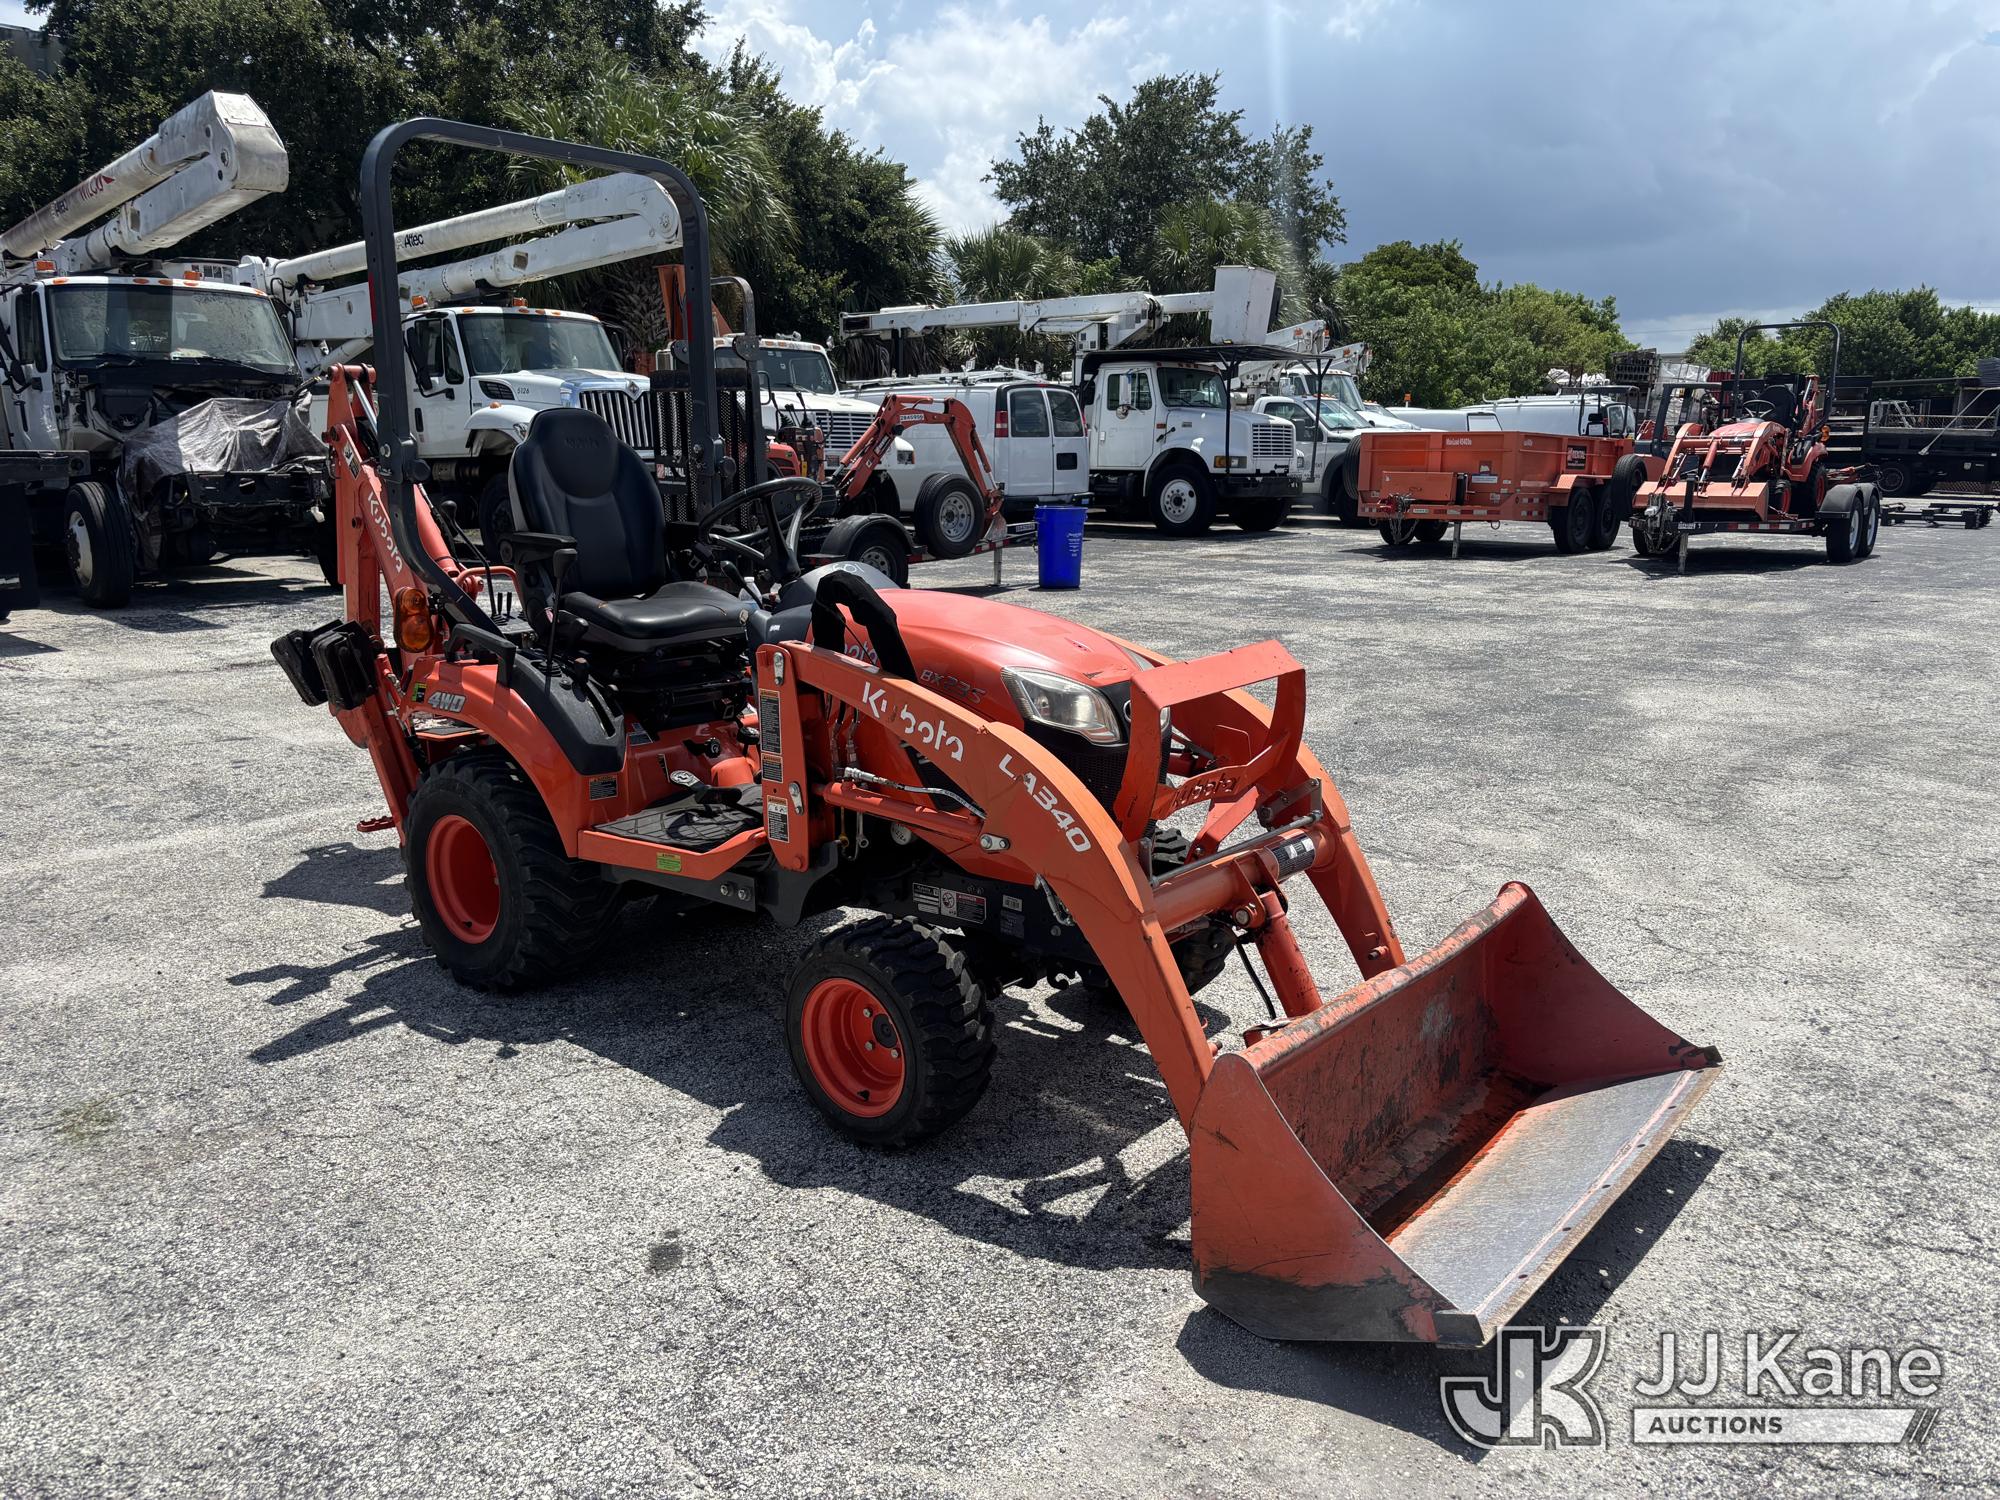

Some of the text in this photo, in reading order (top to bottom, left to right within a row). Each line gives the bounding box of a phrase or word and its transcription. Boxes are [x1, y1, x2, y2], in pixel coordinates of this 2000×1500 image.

[405, 233, 424, 248] Altec
[367, 491, 404, 574] Kubota
[427, 691, 467, 713] 4WD
[862, 681, 965, 763] Kubota
[998, 753, 1092, 853] LA340
